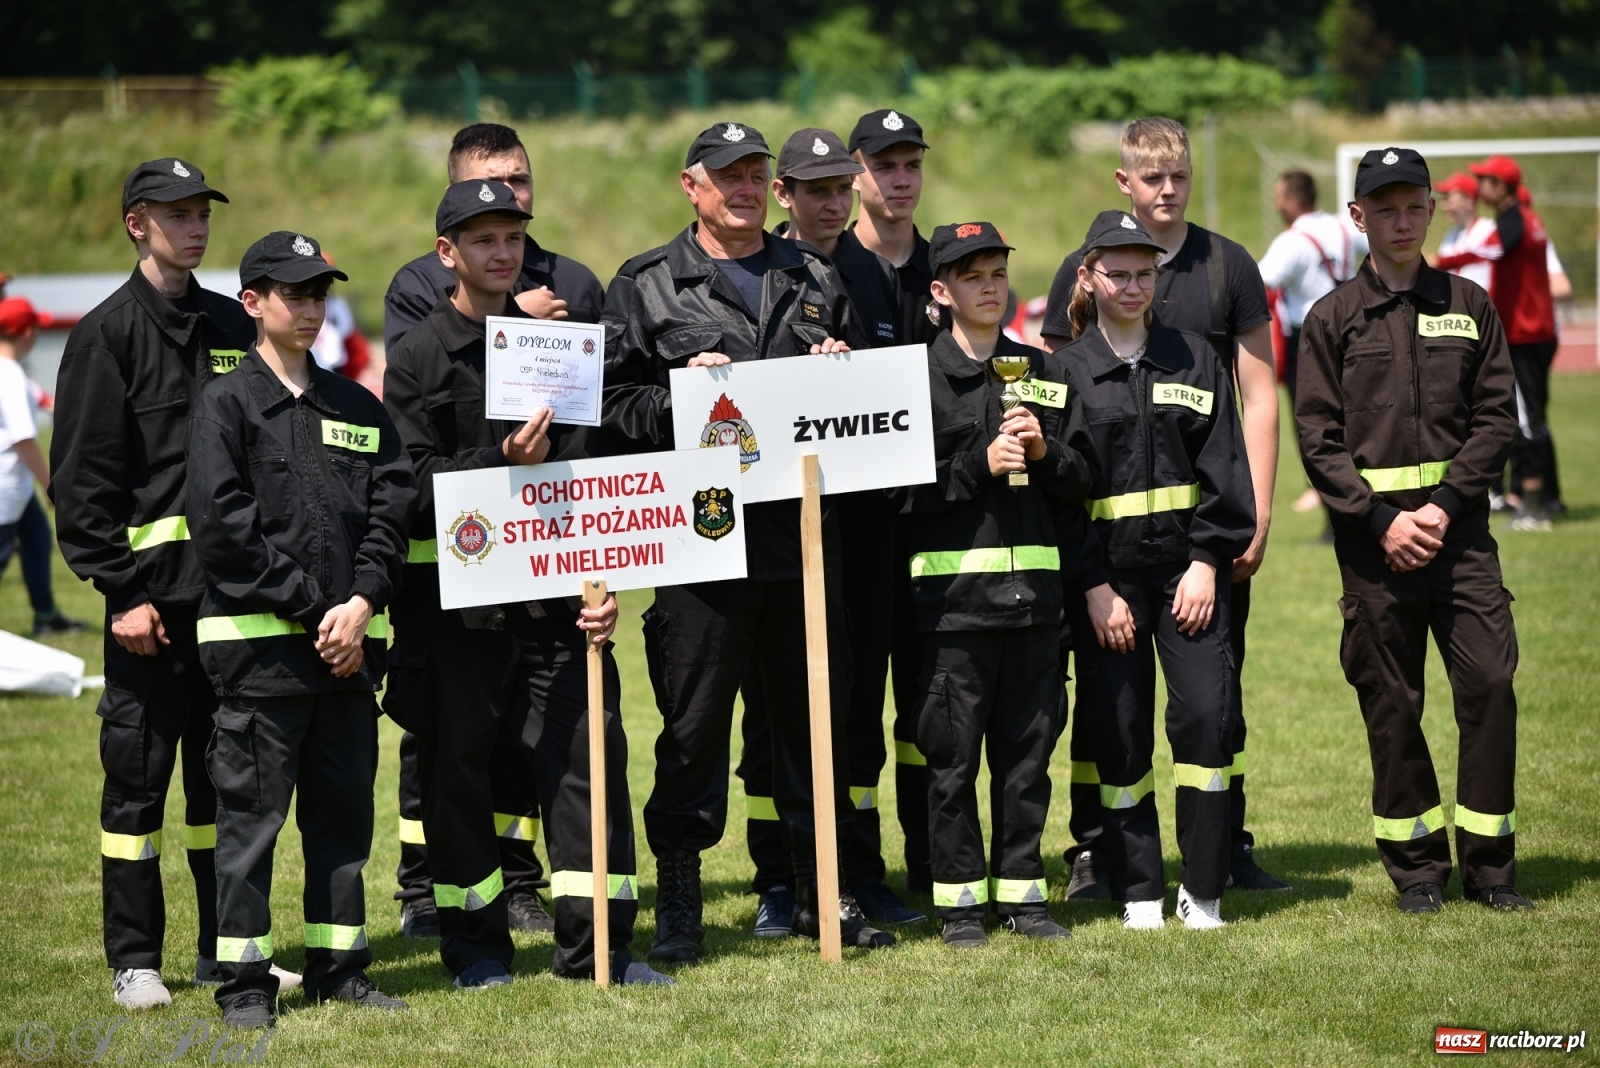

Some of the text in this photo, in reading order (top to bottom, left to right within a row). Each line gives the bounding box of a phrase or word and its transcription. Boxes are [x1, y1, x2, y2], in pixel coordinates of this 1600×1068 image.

[517, 335, 572, 351] DYPLOM
[519, 365, 534, 374] OSP
[793, 409, 909, 443] ŻYWIEC
[521, 471, 665, 506] OCHOTNICZA
[699, 489, 727, 501] OSP
[503, 511, 576, 544] STRAŻ
[581, 504, 687, 537] POŻARNA
[696, 521, 733, 537] NIELEDWIA
[530, 542, 664, 577] W NIELEDWII
